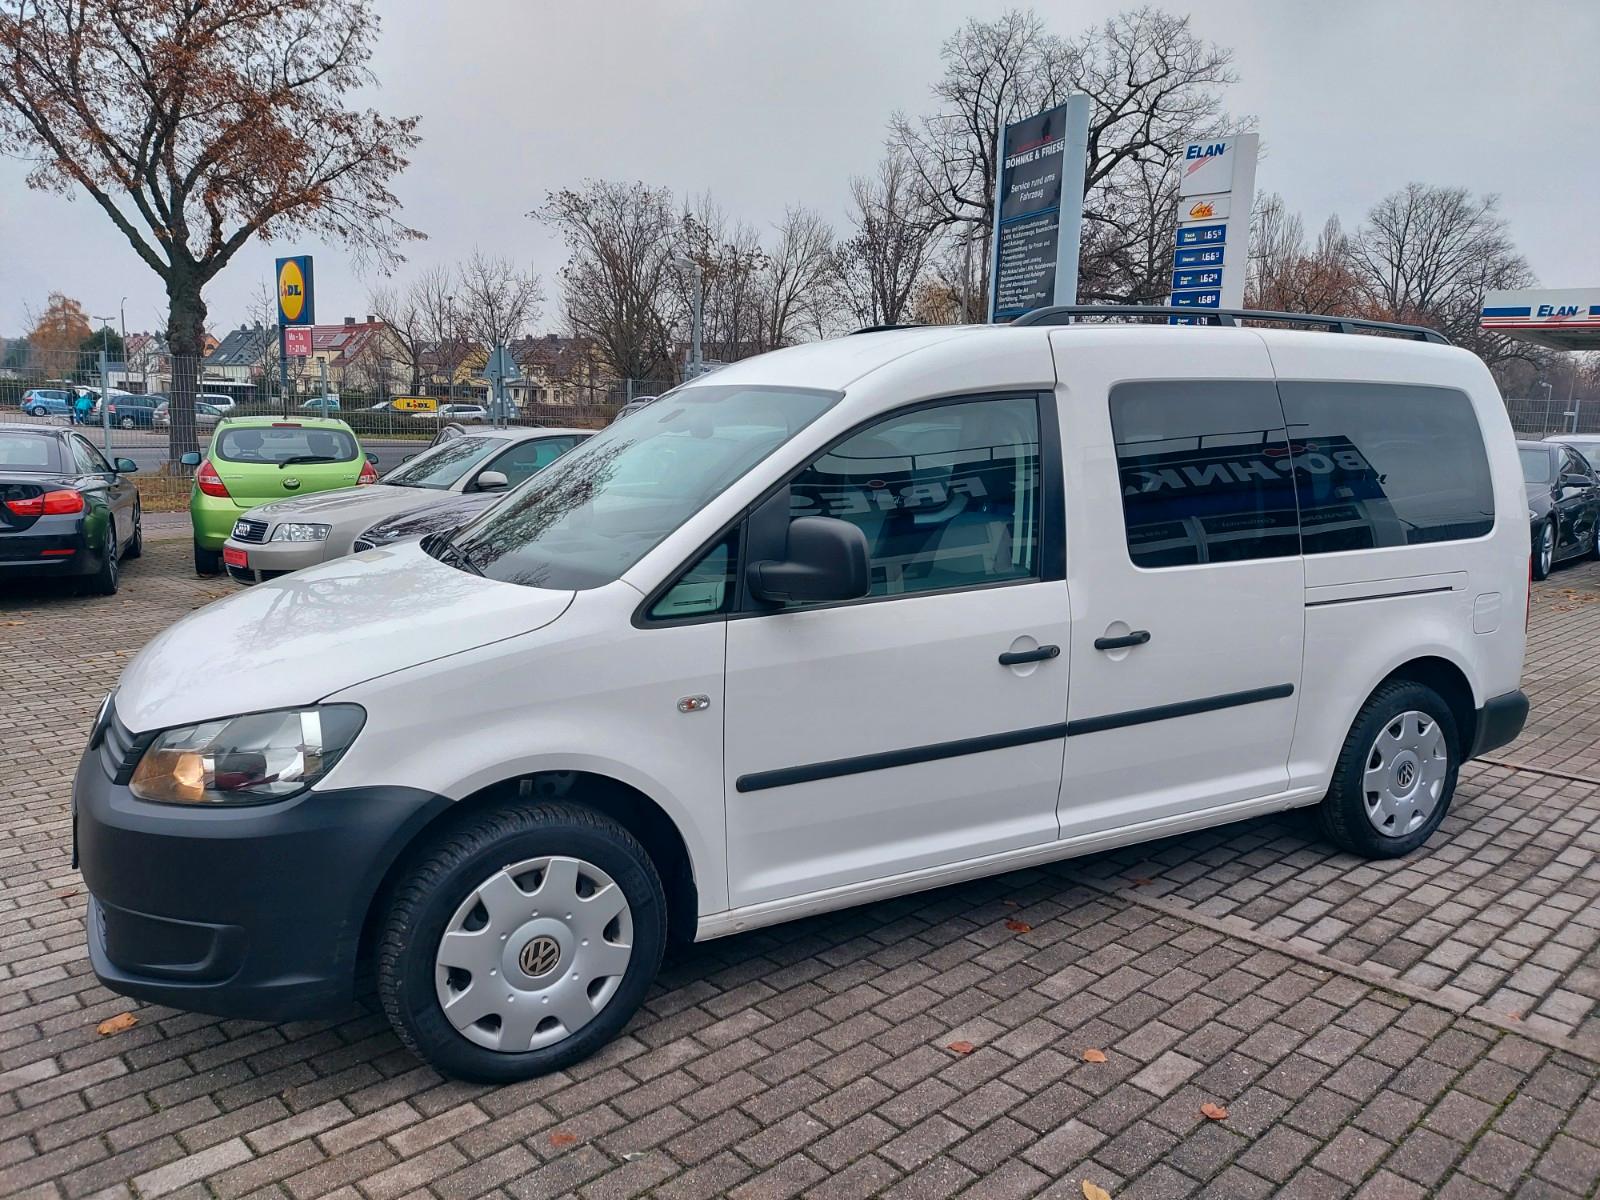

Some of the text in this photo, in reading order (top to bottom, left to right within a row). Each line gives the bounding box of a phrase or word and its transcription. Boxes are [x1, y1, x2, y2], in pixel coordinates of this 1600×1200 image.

[1035, 149, 1041, 160] &
[1041, 140, 1065, 158] FRIESE
[1186, 143, 1226, 160] ELAN
[1537, 304, 1579, 317] ELAN
